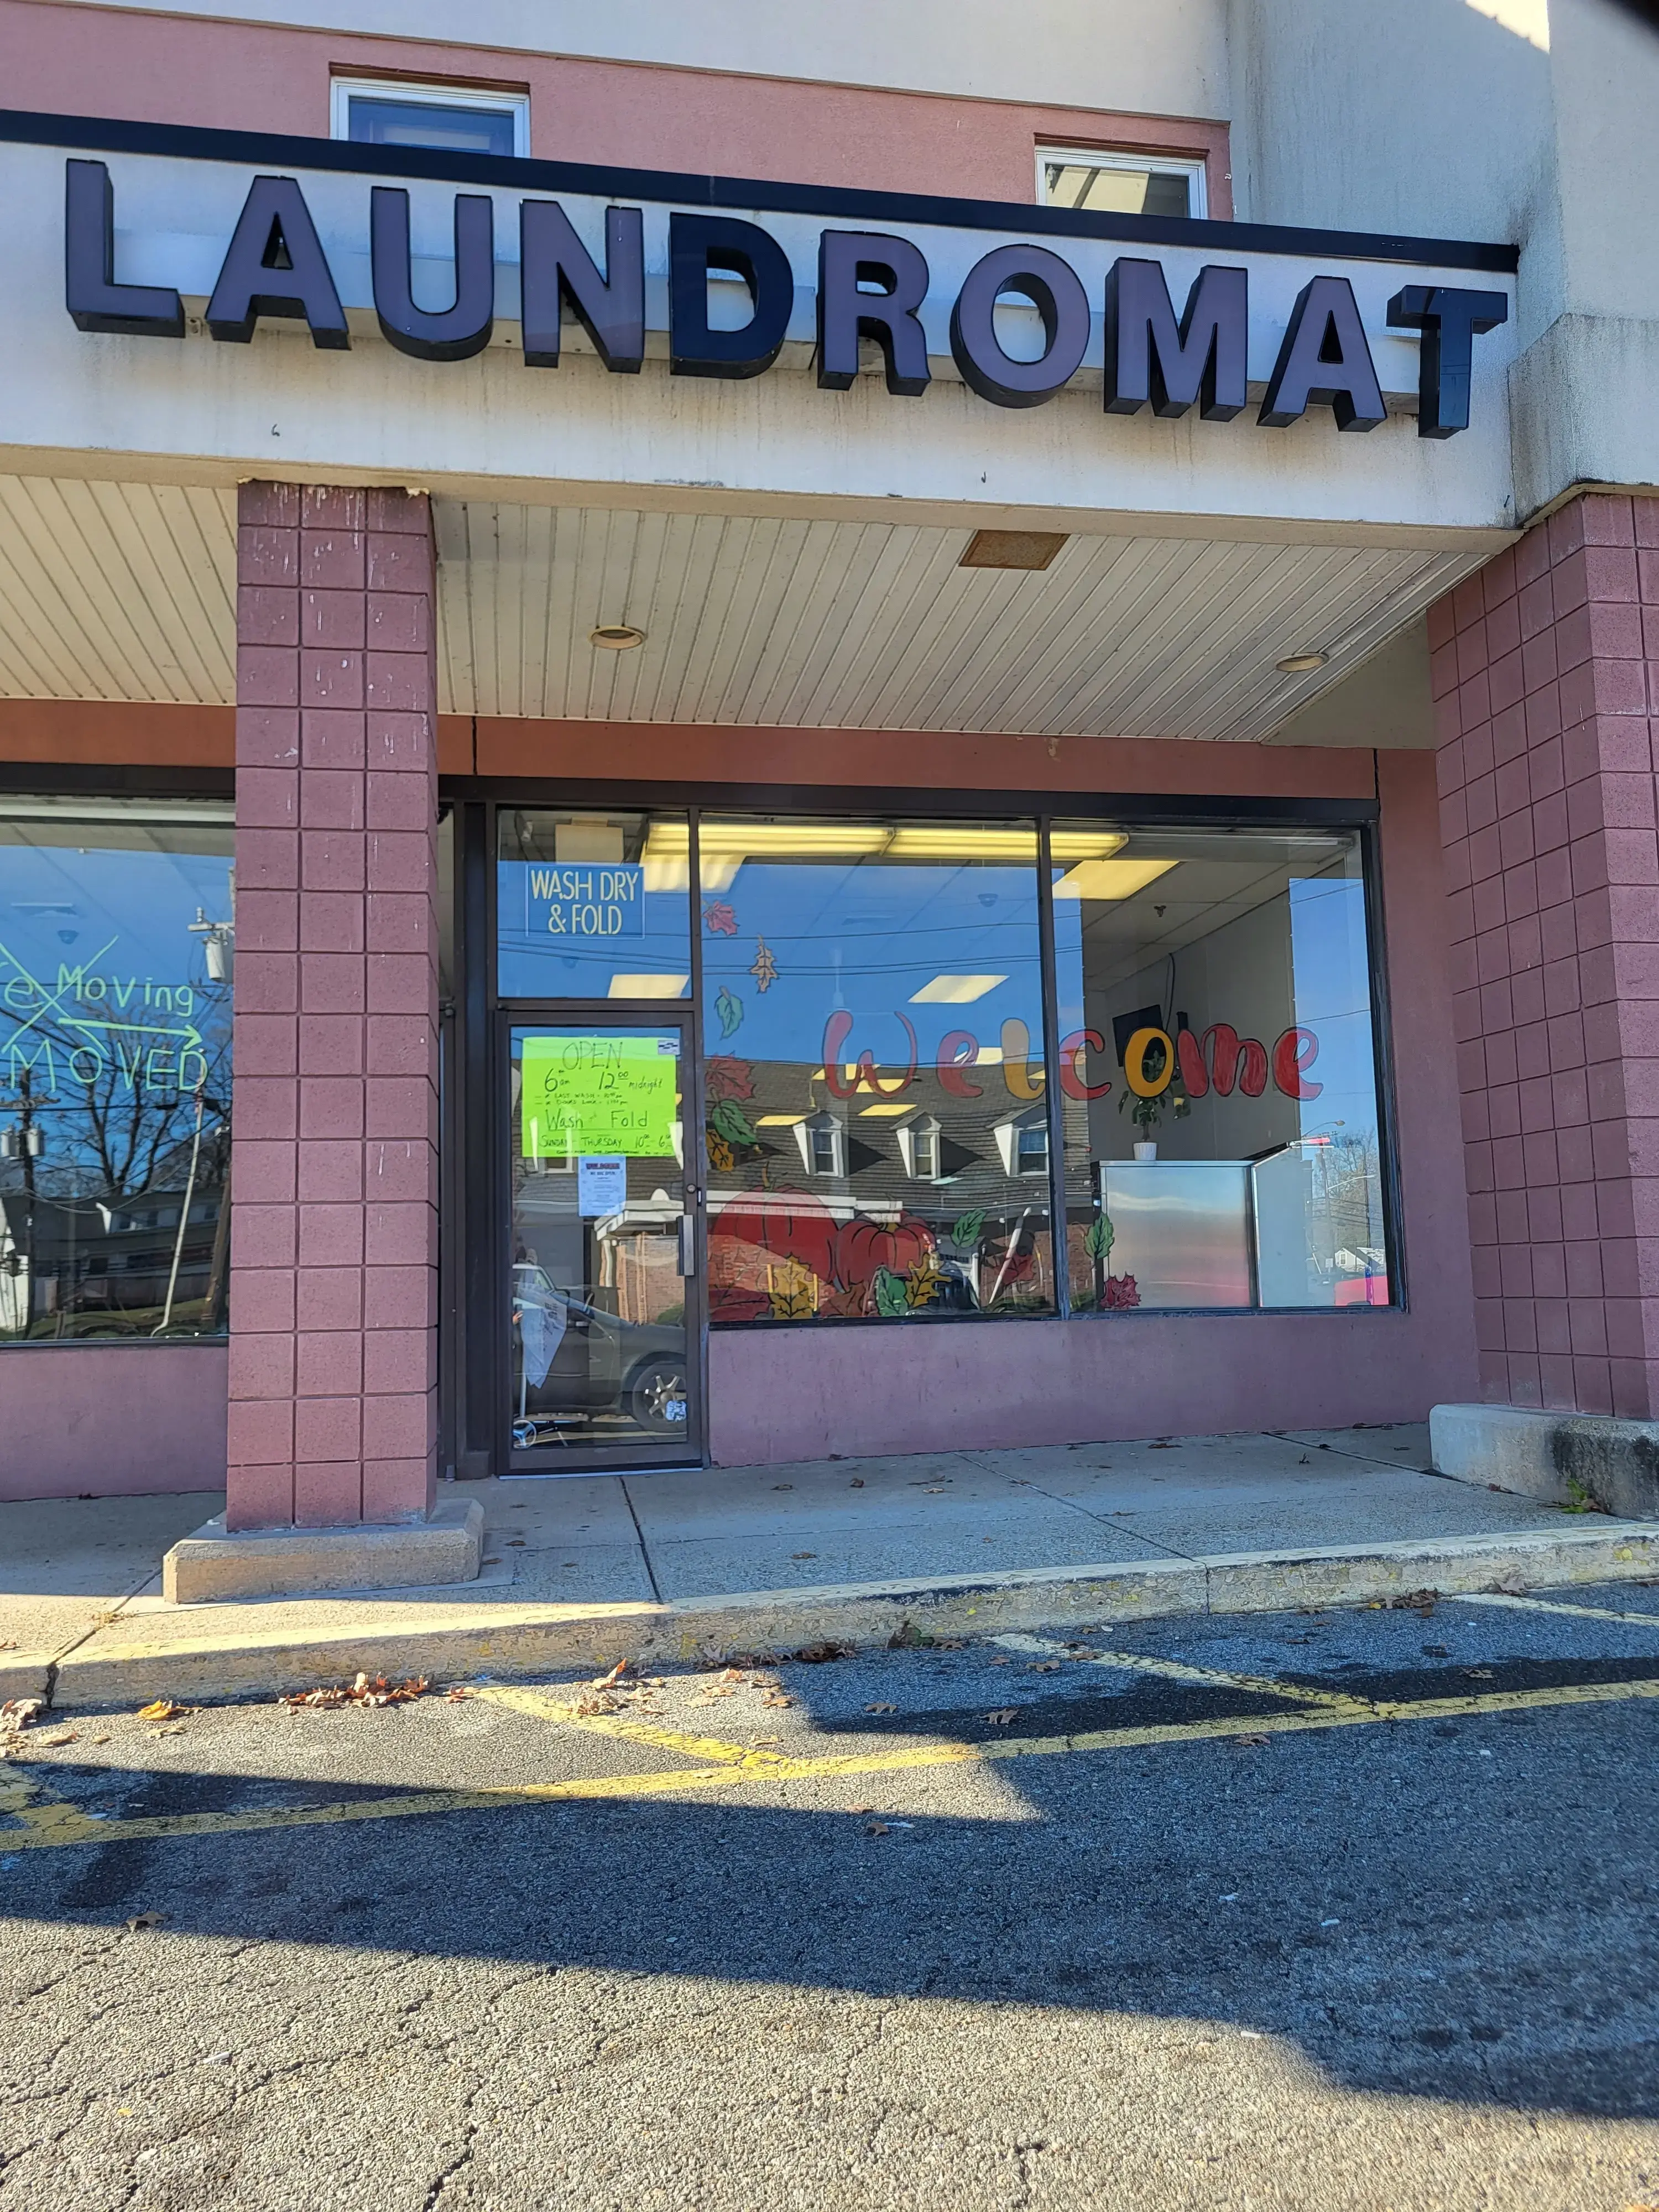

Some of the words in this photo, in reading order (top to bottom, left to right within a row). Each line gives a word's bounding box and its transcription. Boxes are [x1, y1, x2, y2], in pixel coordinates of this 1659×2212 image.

[65, 158, 1507, 439] LAUNDROMAT
[531, 869, 592, 900] WASH
[600, 872, 639, 901] DRY
[548, 904, 567, 933] &
[572, 904, 622, 935] FOLD
[10, 1039, 208, 1093] MOVED
[562, 1040, 623, 1071] OPEN
[821, 1009, 1324, 1102] Welcome
[628, 1076, 662, 1094] midnight
[545, 1108, 583, 1129] Wash
[611, 1110, 648, 1127] Fold
